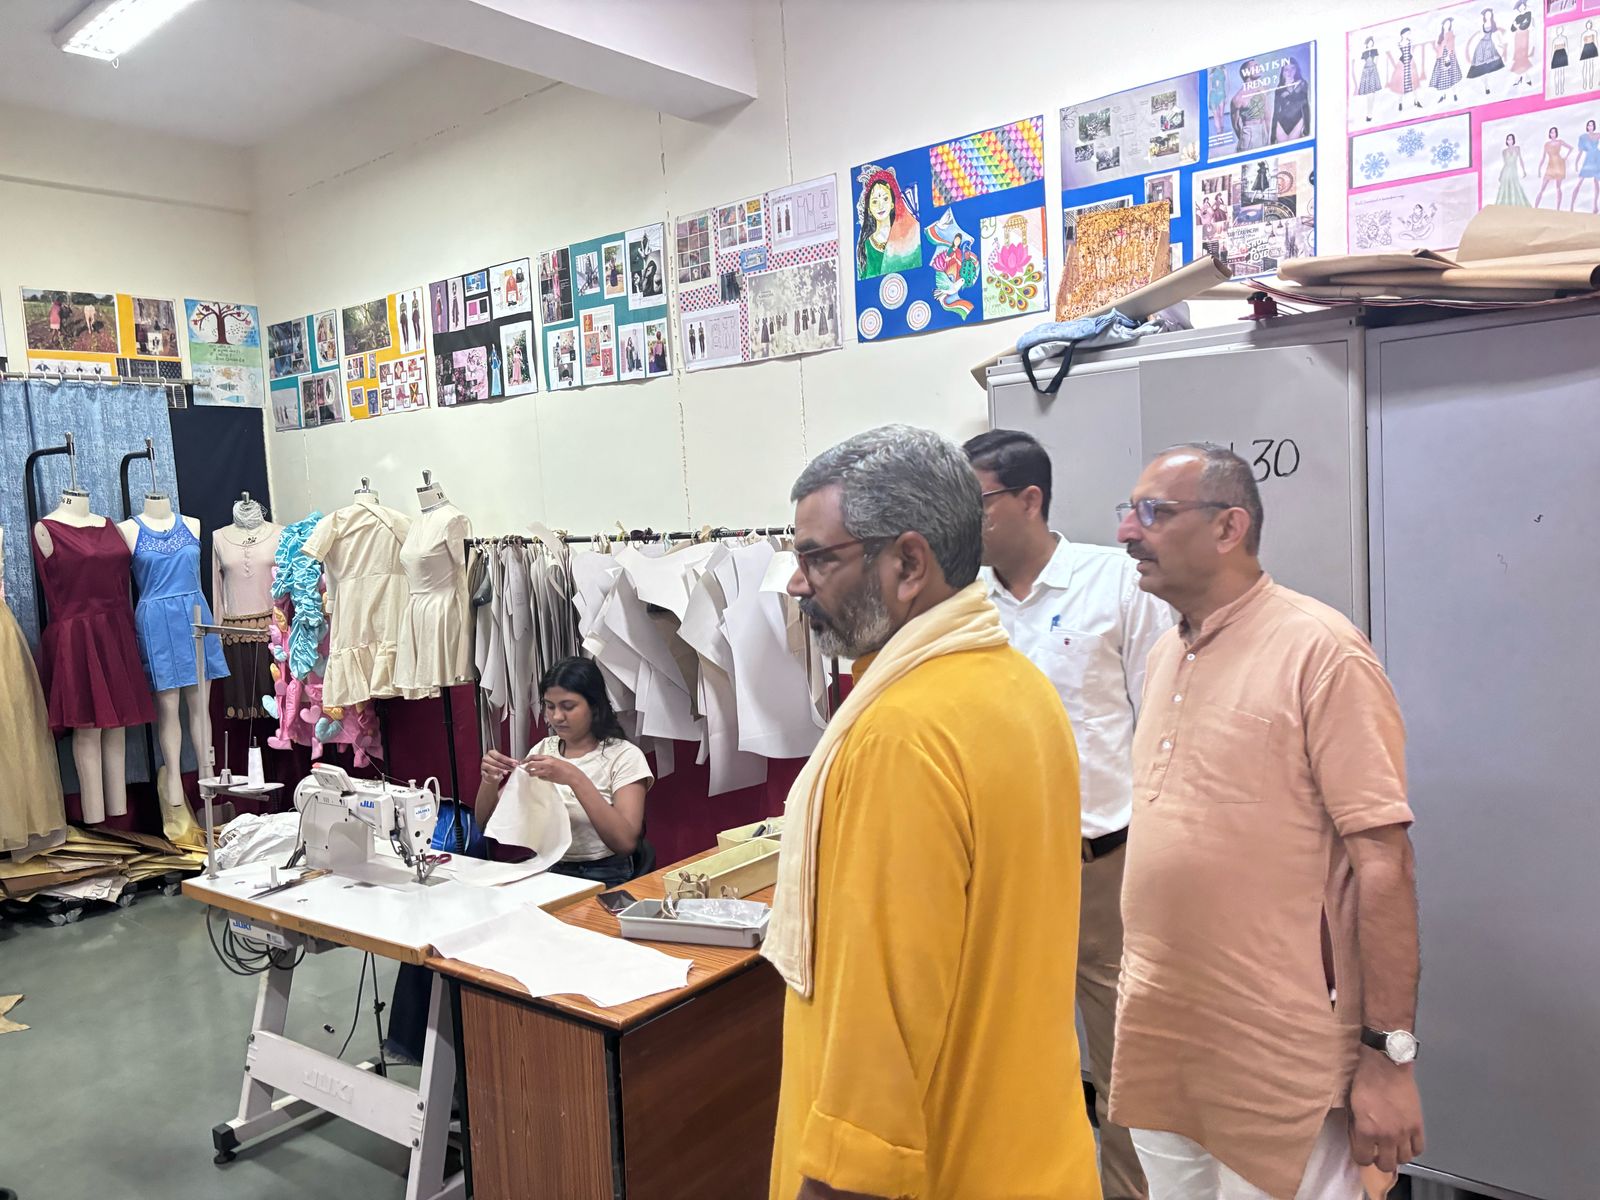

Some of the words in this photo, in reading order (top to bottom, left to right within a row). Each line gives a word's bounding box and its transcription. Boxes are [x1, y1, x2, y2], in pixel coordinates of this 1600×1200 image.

[1241, 62, 1269, 77] WHAT
[1271, 60, 1280, 68] IS
[1281, 57, 1291, 66] IN
[1242, 78, 1271, 91] TREND
[1252, 438, 1300, 483] 30
[232, 919, 251, 931] JUKI
